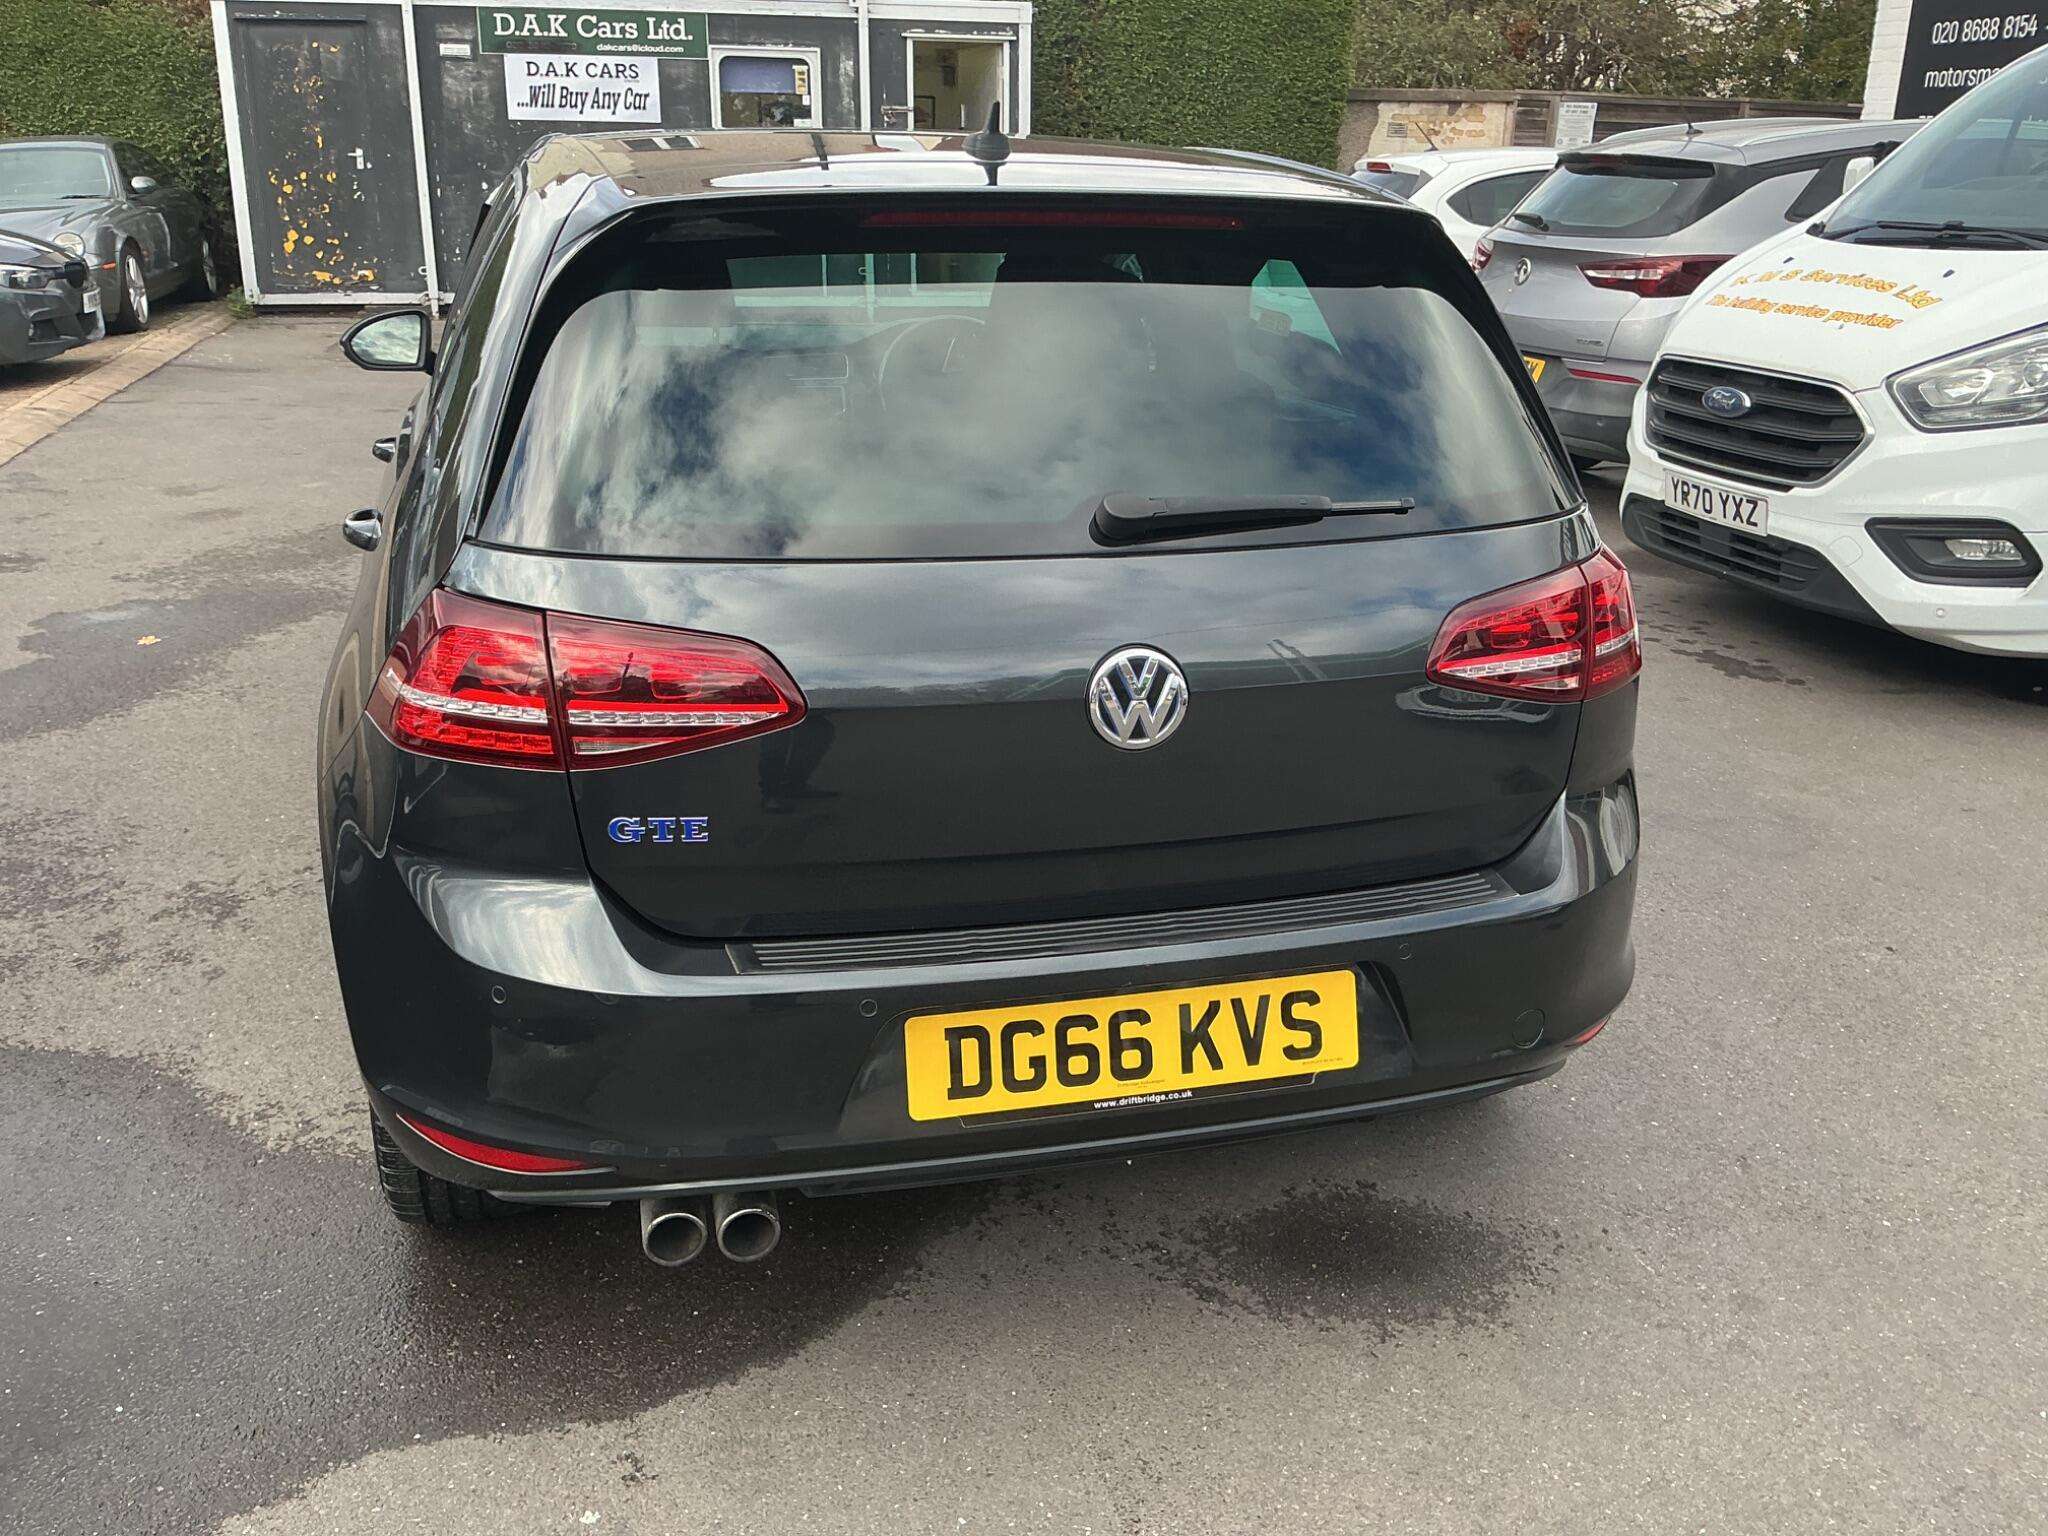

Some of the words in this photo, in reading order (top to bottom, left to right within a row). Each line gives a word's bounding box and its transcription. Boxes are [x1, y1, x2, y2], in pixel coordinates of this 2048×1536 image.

[493, 13, 568, 38] D.A.K
[576, 15, 638, 39] Cars
[646, 17, 694, 41] Ltd.
[1931, 20, 1960, 44] 020
[1961, 17, 2000, 42] 8688
[2002, 14, 2038, 39] 8154
[526, 61, 579, 78] D.A.K
[585, 63, 639, 79] CARS
[558, 86, 589, 114] Buy
[591, 87, 622, 115] Any
[624, 88, 650, 111] Car
[1801, 269, 1898, 293] Services
[1892, 284, 1943, 310] Ltd
[1773, 303, 1830, 319] service
[1823, 309, 1904, 330] provider
[1671, 476, 1713, 515] YR70
[1718, 491, 1759, 527] YXZ
[607, 816, 709, 843] GTE
[944, 1008, 1153, 1100] DG66
[1178, 988, 1323, 1075] KVS
[1093, 1089, 1193, 1109] www.driftbridge.co.uk
